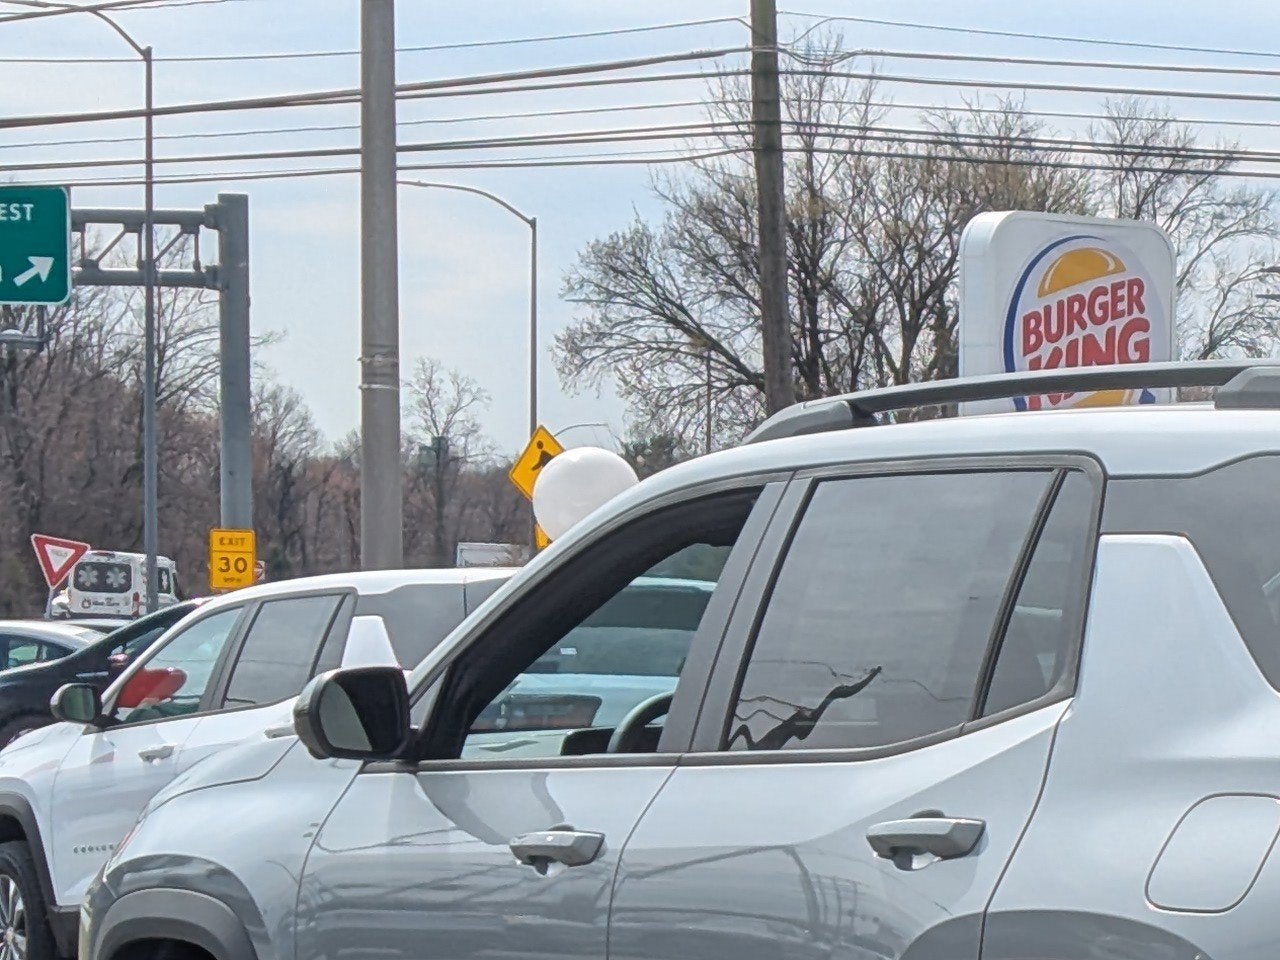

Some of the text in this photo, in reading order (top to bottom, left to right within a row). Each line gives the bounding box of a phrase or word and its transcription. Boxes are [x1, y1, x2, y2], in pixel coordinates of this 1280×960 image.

[0, 203, 34, 221] EST
[1022, 277, 1146, 357] BURGER
[218, 556, 248, 573] 30
